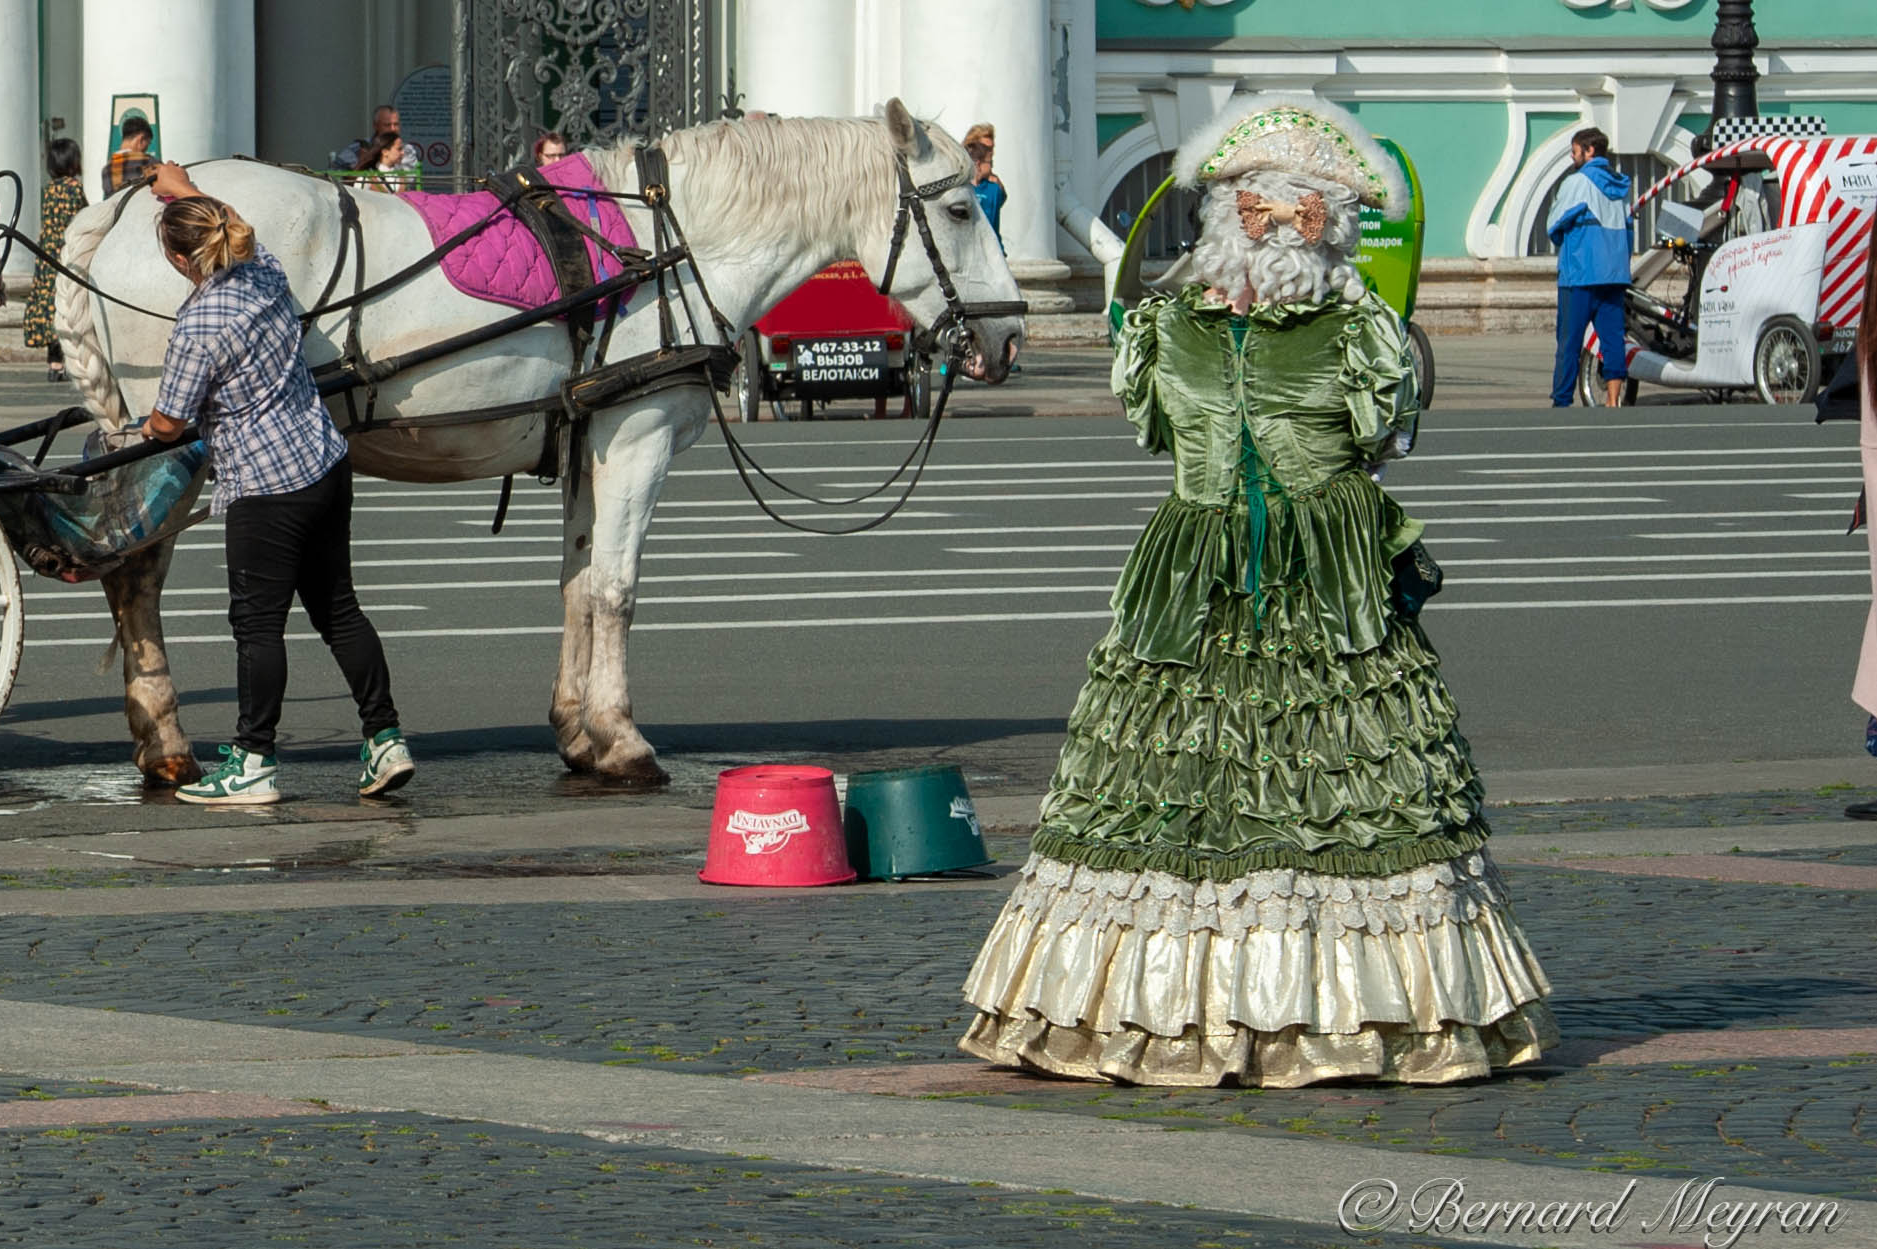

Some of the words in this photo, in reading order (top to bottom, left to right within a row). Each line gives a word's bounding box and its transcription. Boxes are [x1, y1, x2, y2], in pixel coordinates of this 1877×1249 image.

[1360, 238, 1403, 249] подарок
[812, 340, 881, 353] 467-33-12
[817, 354, 864, 366] ВЫЗОВ
[802, 368, 880, 381] ВЕЛОТАКСИ
